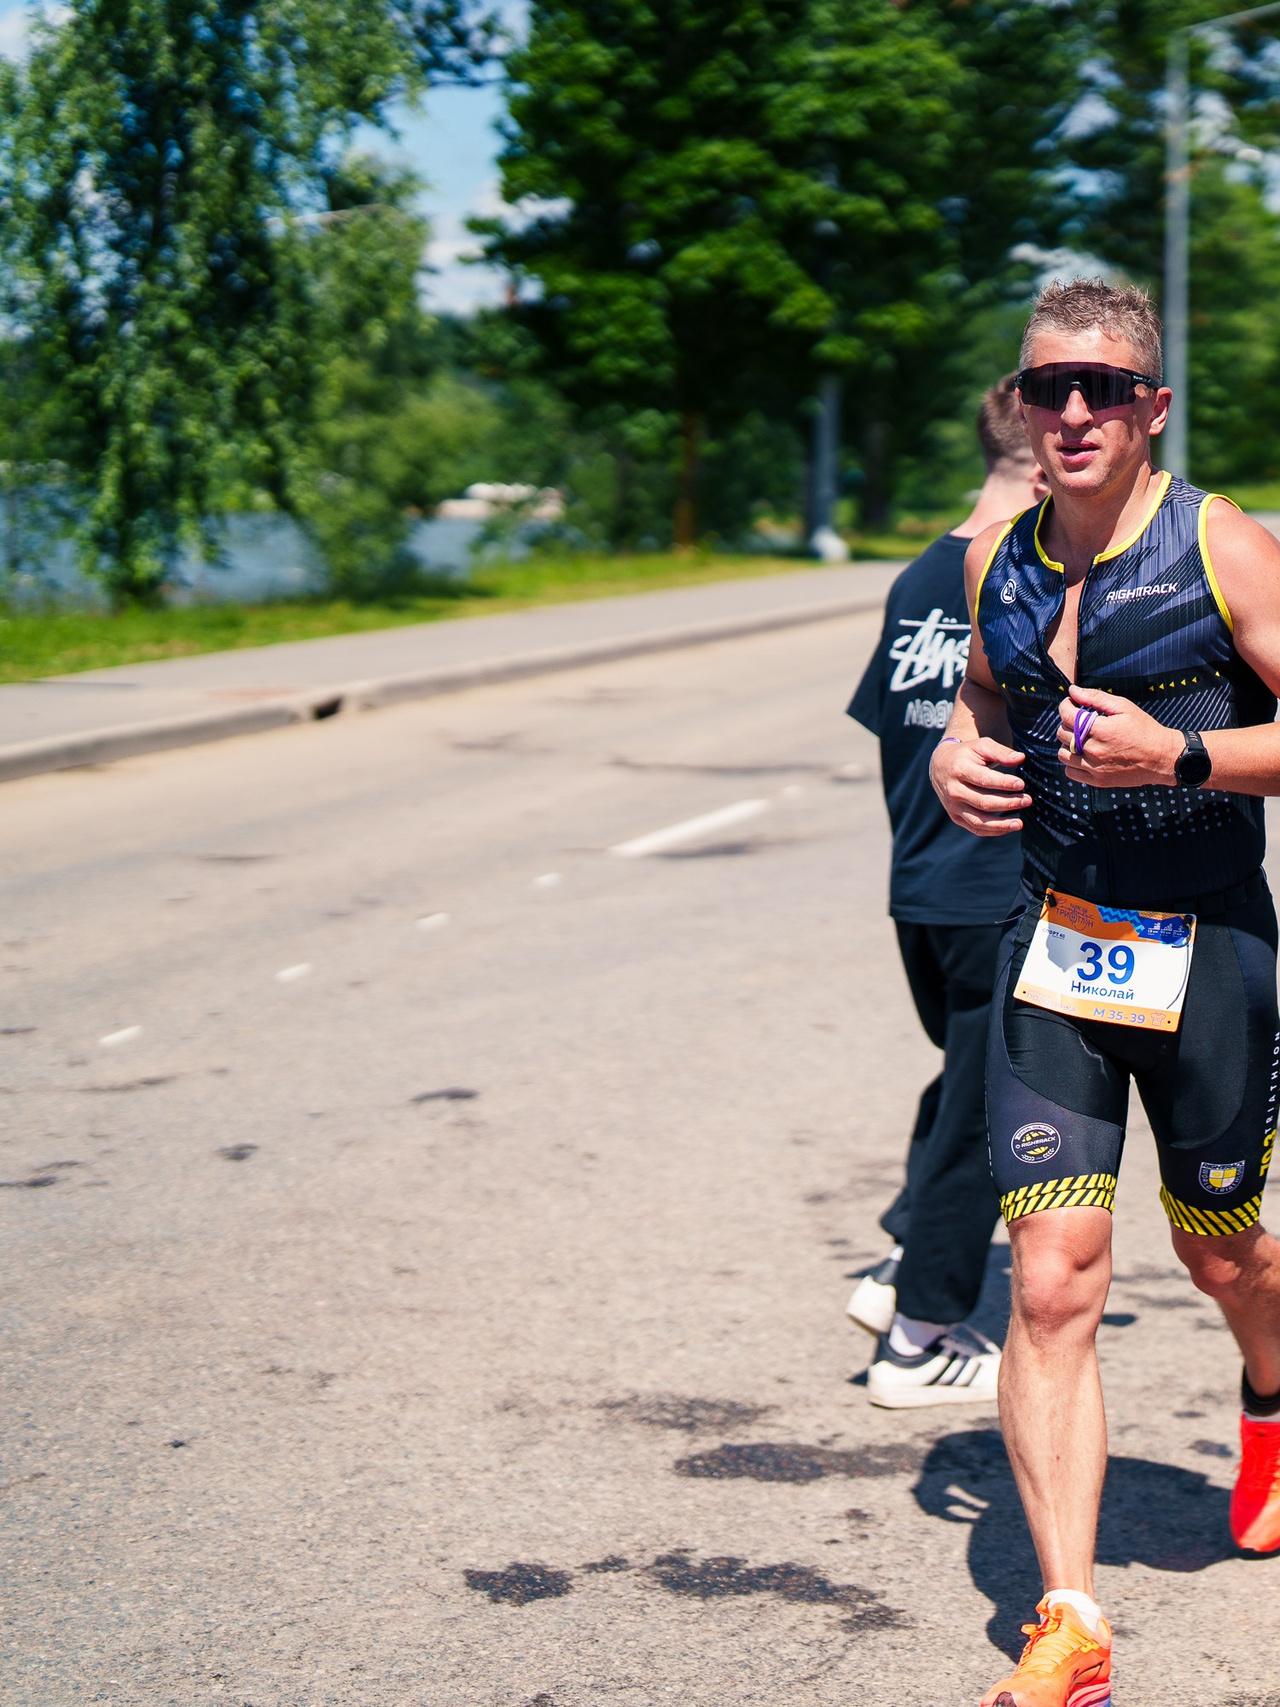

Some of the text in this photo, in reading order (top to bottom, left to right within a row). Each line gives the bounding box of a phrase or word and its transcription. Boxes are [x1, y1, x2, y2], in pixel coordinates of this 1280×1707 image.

[1076, 941, 1135, 984] 39
[1071, 980, 1135, 1000] Николай
[1093, 1007, 1146, 1024] М 35-39
[1264, 1031, 1280, 1135] TRIATHLON
